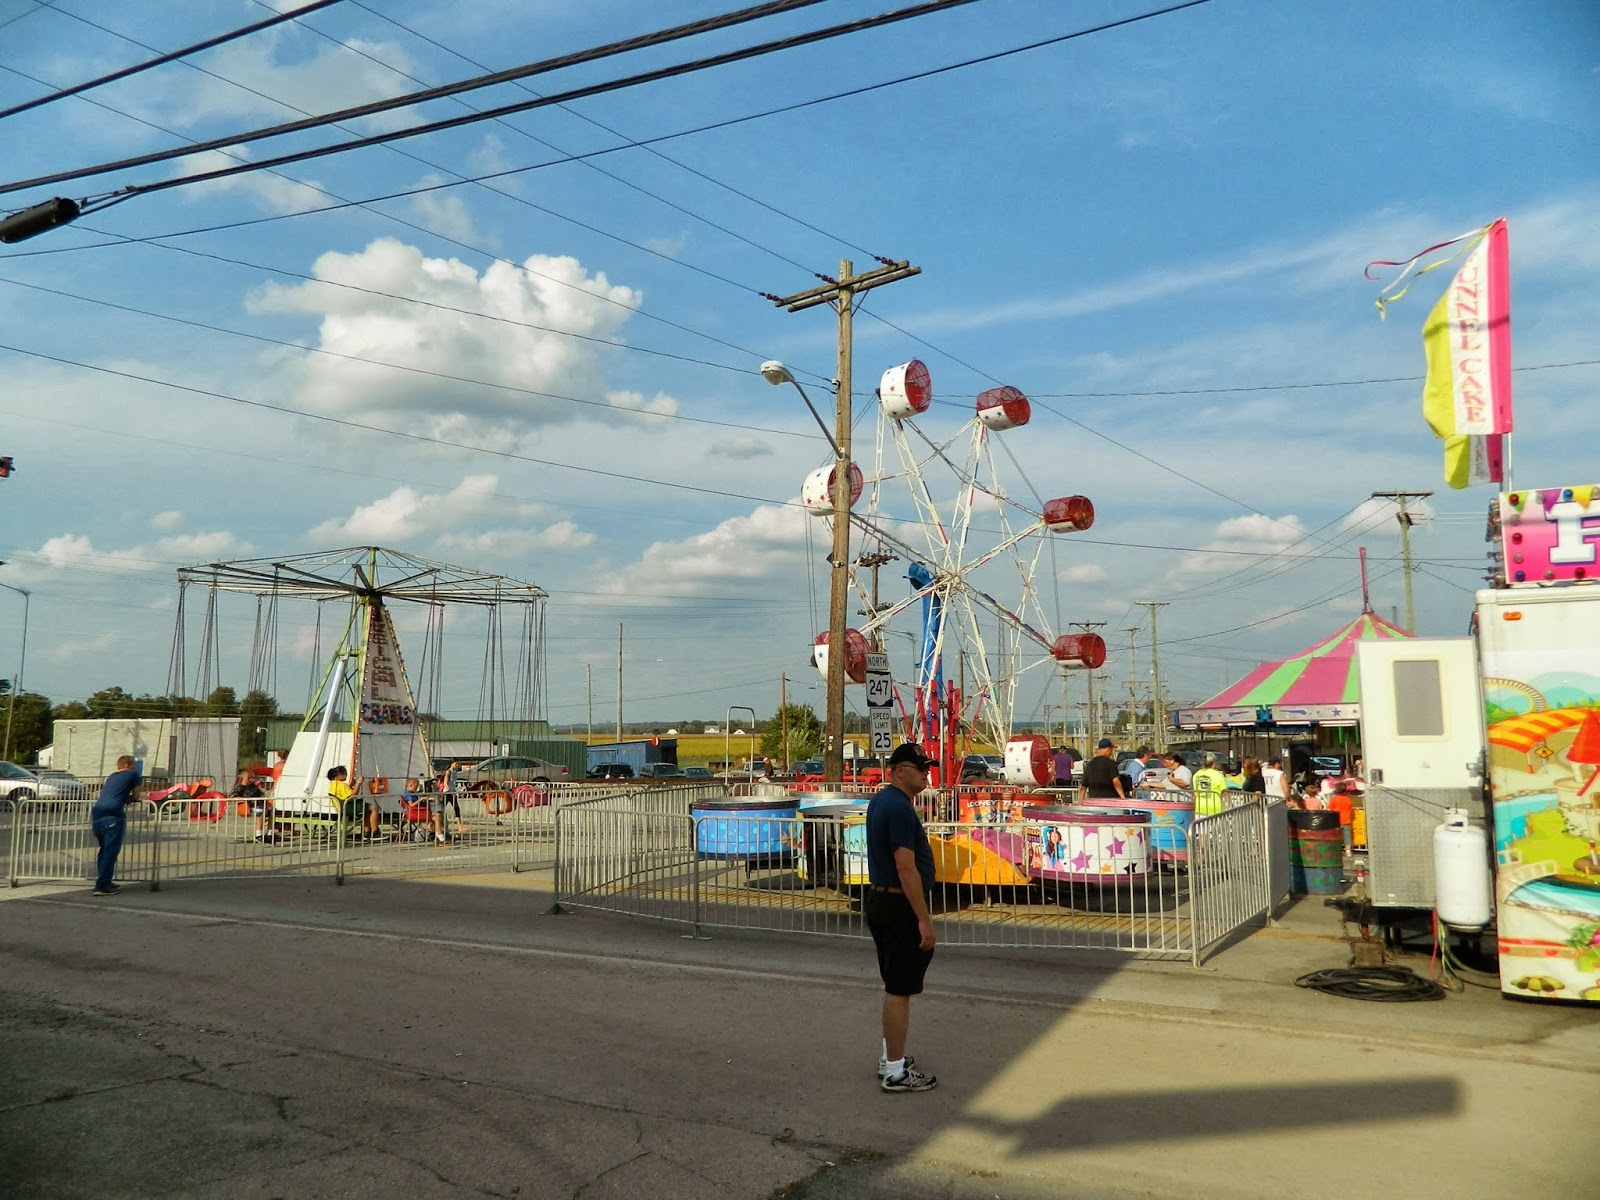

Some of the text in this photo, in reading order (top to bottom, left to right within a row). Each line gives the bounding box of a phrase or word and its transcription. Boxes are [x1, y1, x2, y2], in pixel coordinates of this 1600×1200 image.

[1455, 252, 1486, 424] UNNEL CAKE
[868, 656, 887, 667] NORTH
[869, 680, 889, 695] 247
[873, 712, 889, 720] SPEED
[875, 733, 891, 748] 25
[967, 800, 998, 808] LOONEY
